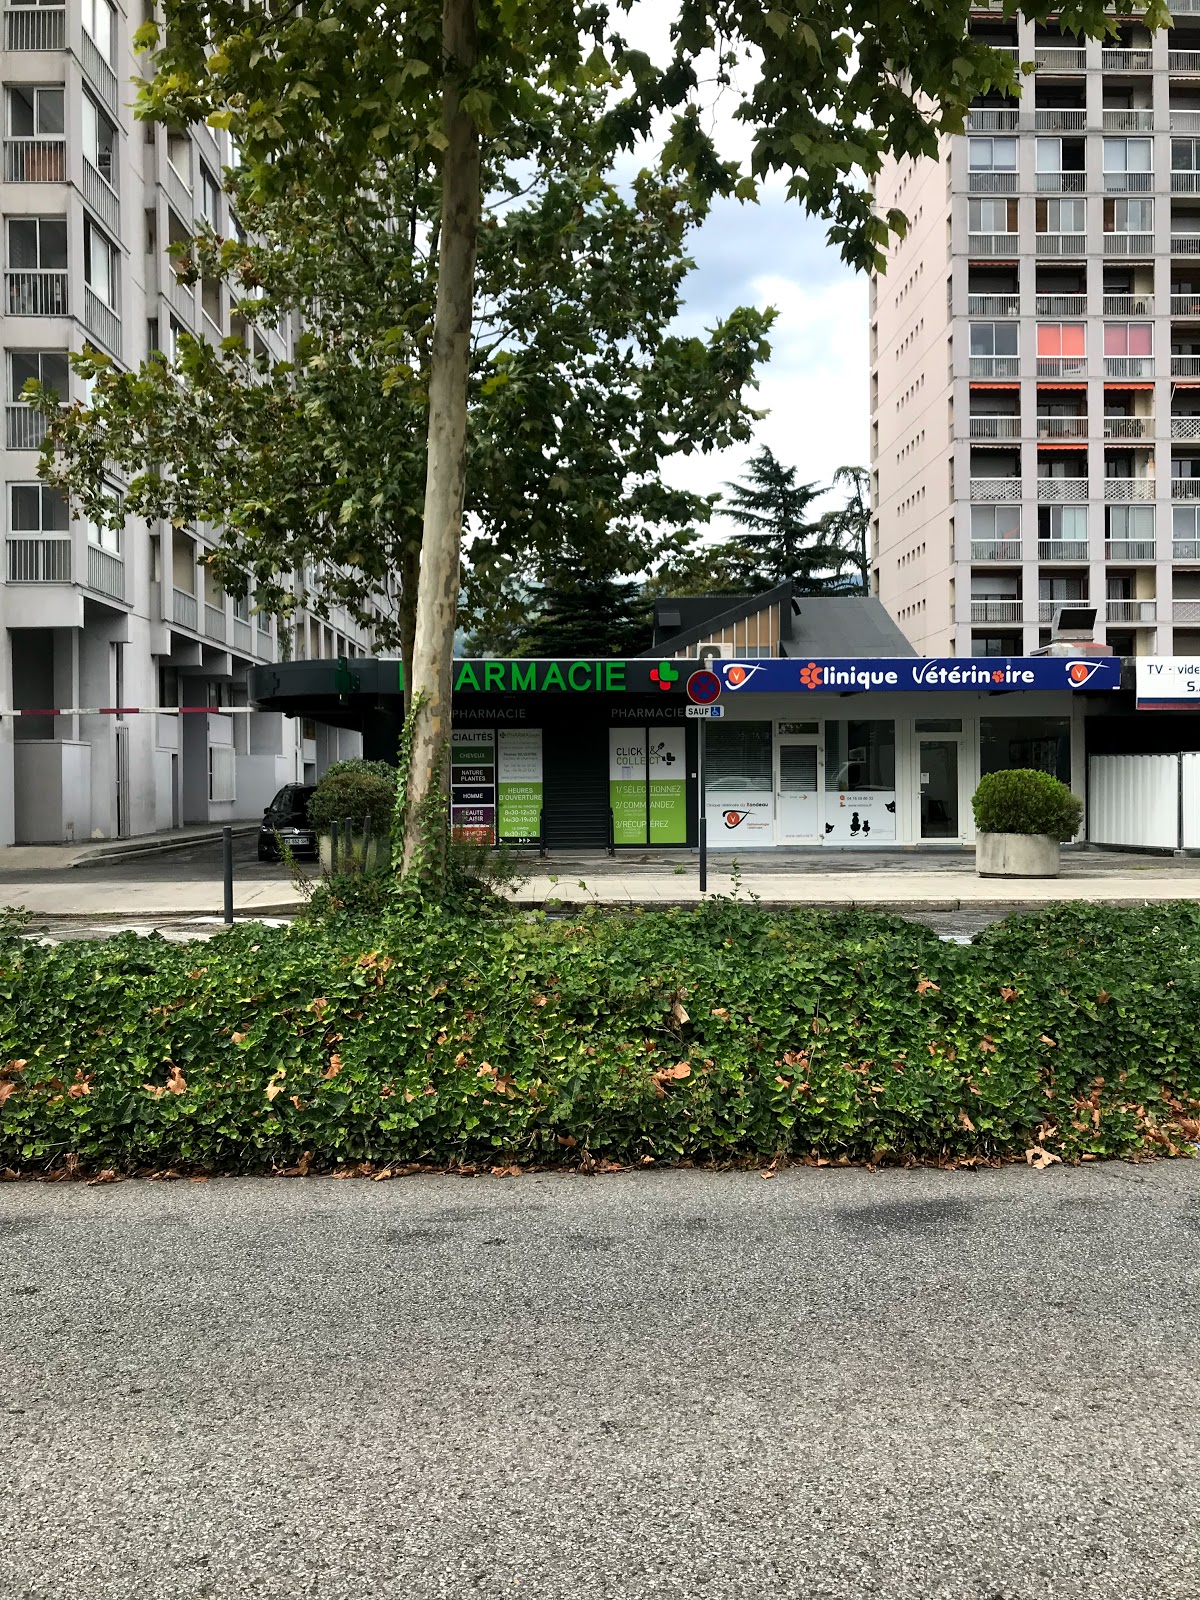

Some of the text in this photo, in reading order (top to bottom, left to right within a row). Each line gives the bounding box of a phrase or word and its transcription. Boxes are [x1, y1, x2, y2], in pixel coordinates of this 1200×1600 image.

[807, 659, 1035, 690] Clinique Vétérinire
[1147, 664, 1164, 675] TV
[399, 661, 626, 691] ARMACIE
[1186, 681, 1200, 693] S.
[452, 708, 526, 719] PHARMACIE
[611, 707, 685, 718] PHARMACIE
[688, 707, 710, 716] SAUF
[451, 729, 493, 741] CIALITÉS
[616, 747, 643, 756] CLICK
[616, 756, 661, 766] COLLECT
[623, 784, 682, 793] SÉLECTIONNEZ
[623, 800, 675, 809] COMMANDEZ
[622, 819, 669, 828] RÉCUPÉREZ
